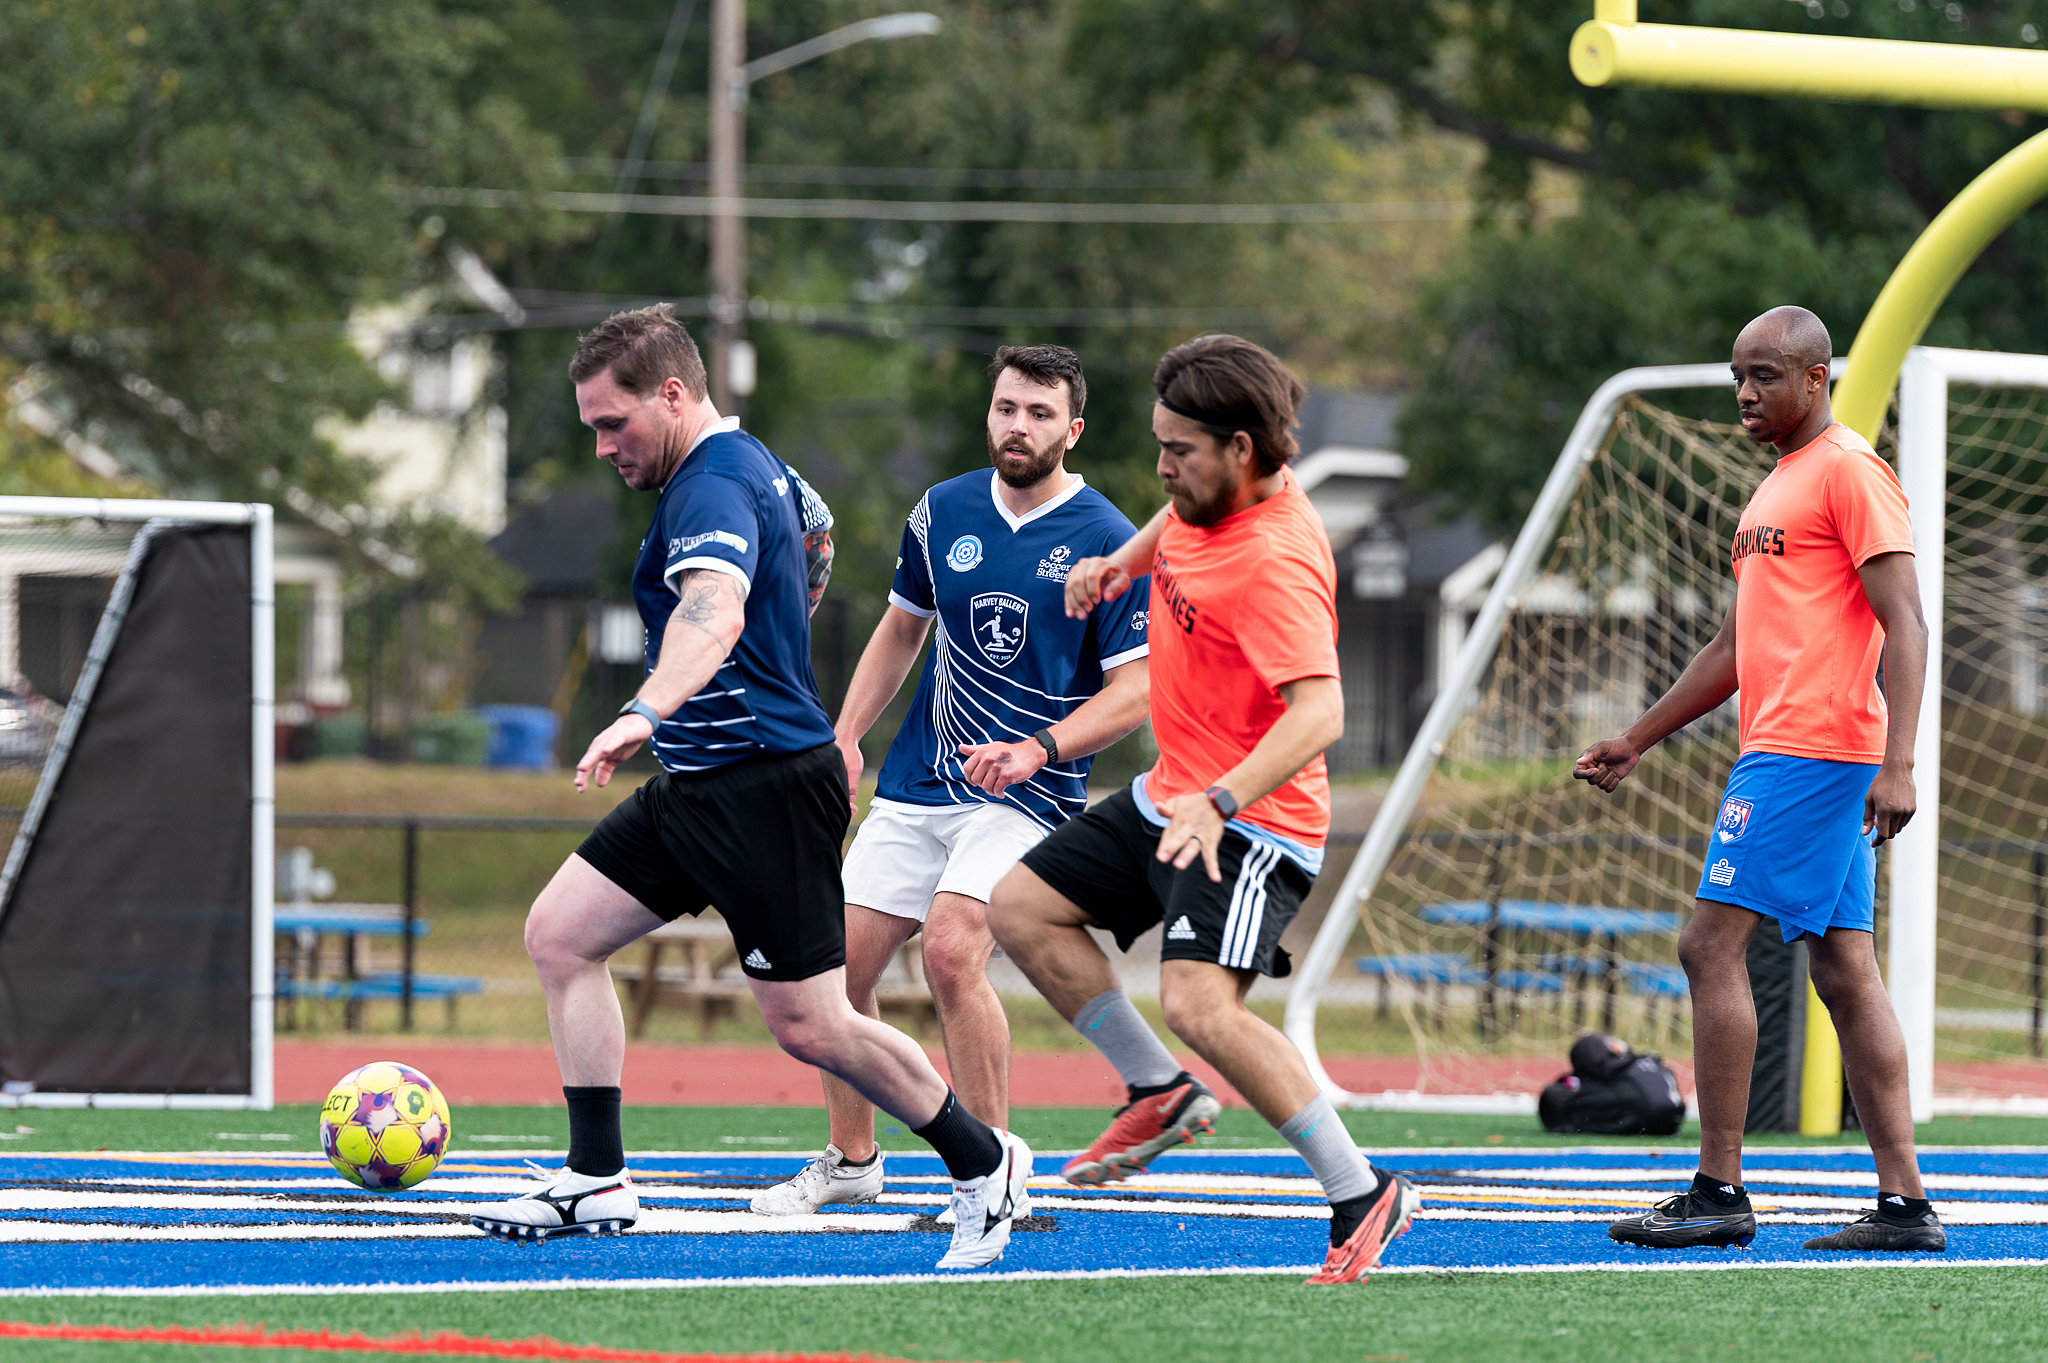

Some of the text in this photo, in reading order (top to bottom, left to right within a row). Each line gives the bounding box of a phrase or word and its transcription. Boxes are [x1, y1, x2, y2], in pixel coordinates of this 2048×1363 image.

[1038, 559, 1071, 571] Soccer
[1036, 568, 1068, 580] Streets
[973, 597, 1025, 614] HARVEY BALLERS
[994, 606, 1003, 614] FC
